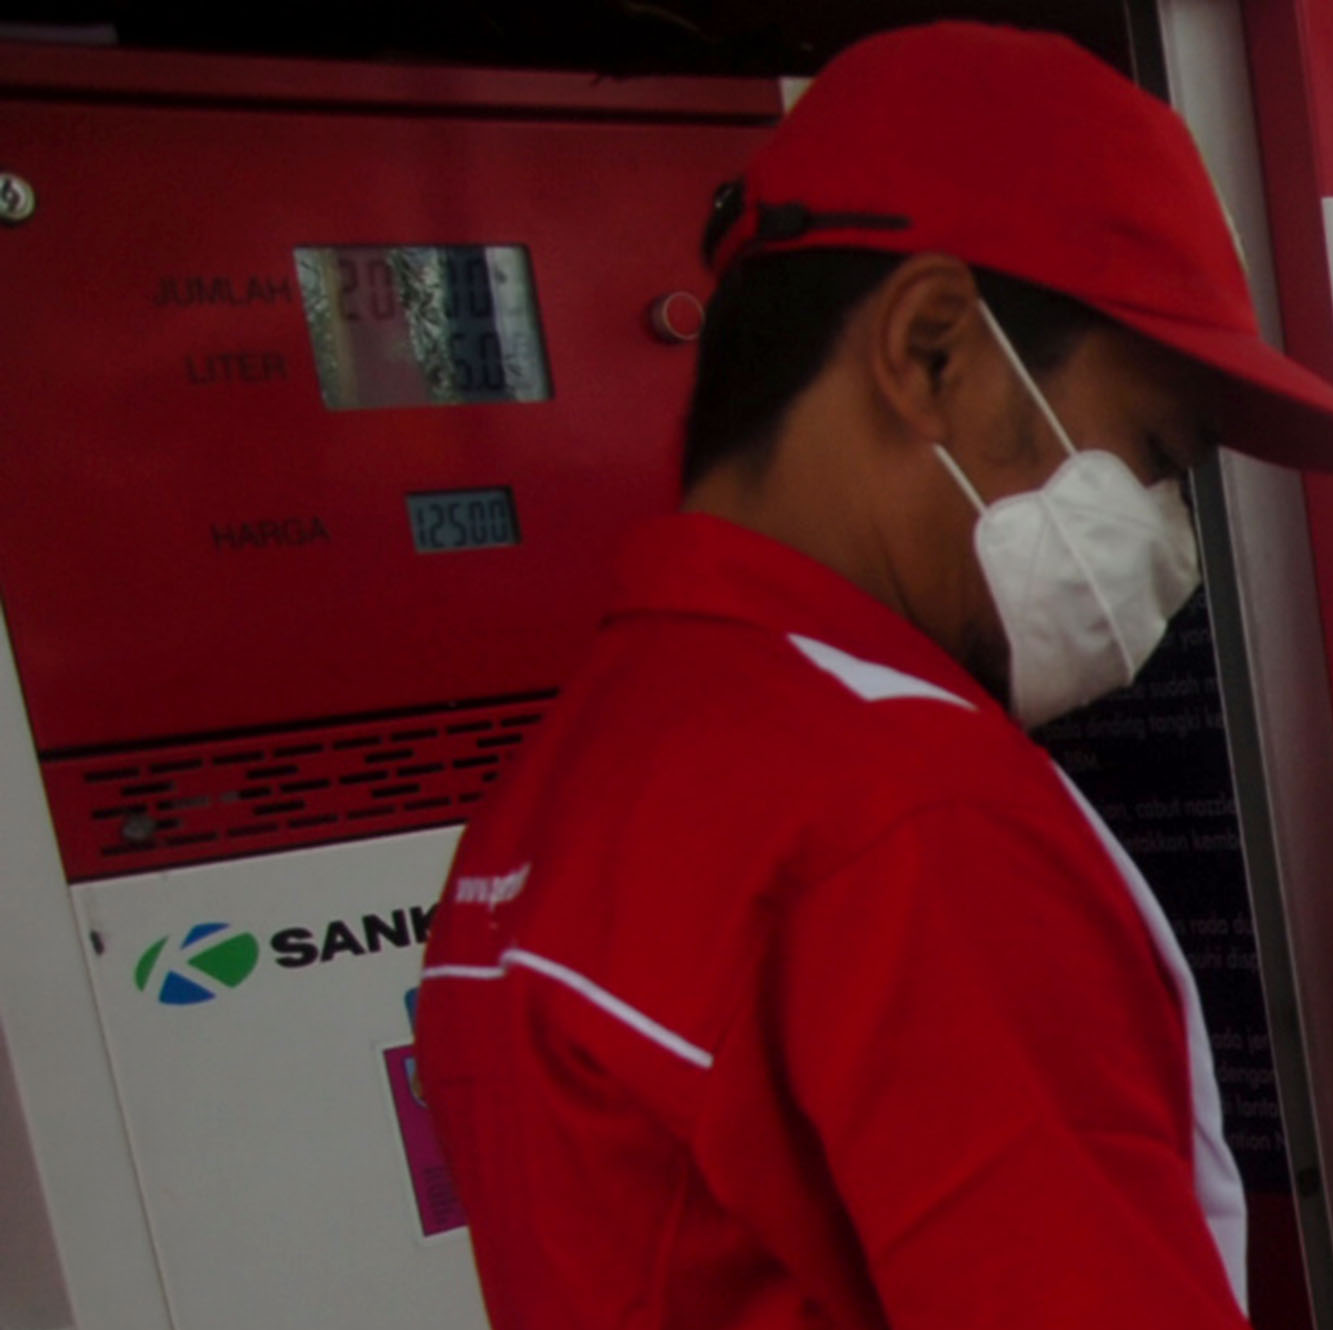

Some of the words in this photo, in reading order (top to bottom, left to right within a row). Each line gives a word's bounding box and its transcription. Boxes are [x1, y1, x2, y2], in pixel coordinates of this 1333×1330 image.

[150, 277, 292, 308] JUMLAH
[185, 351, 288, 385] LITER
[211, 517, 331, 551] HARGA
[416, 499, 509, 549] 12500
